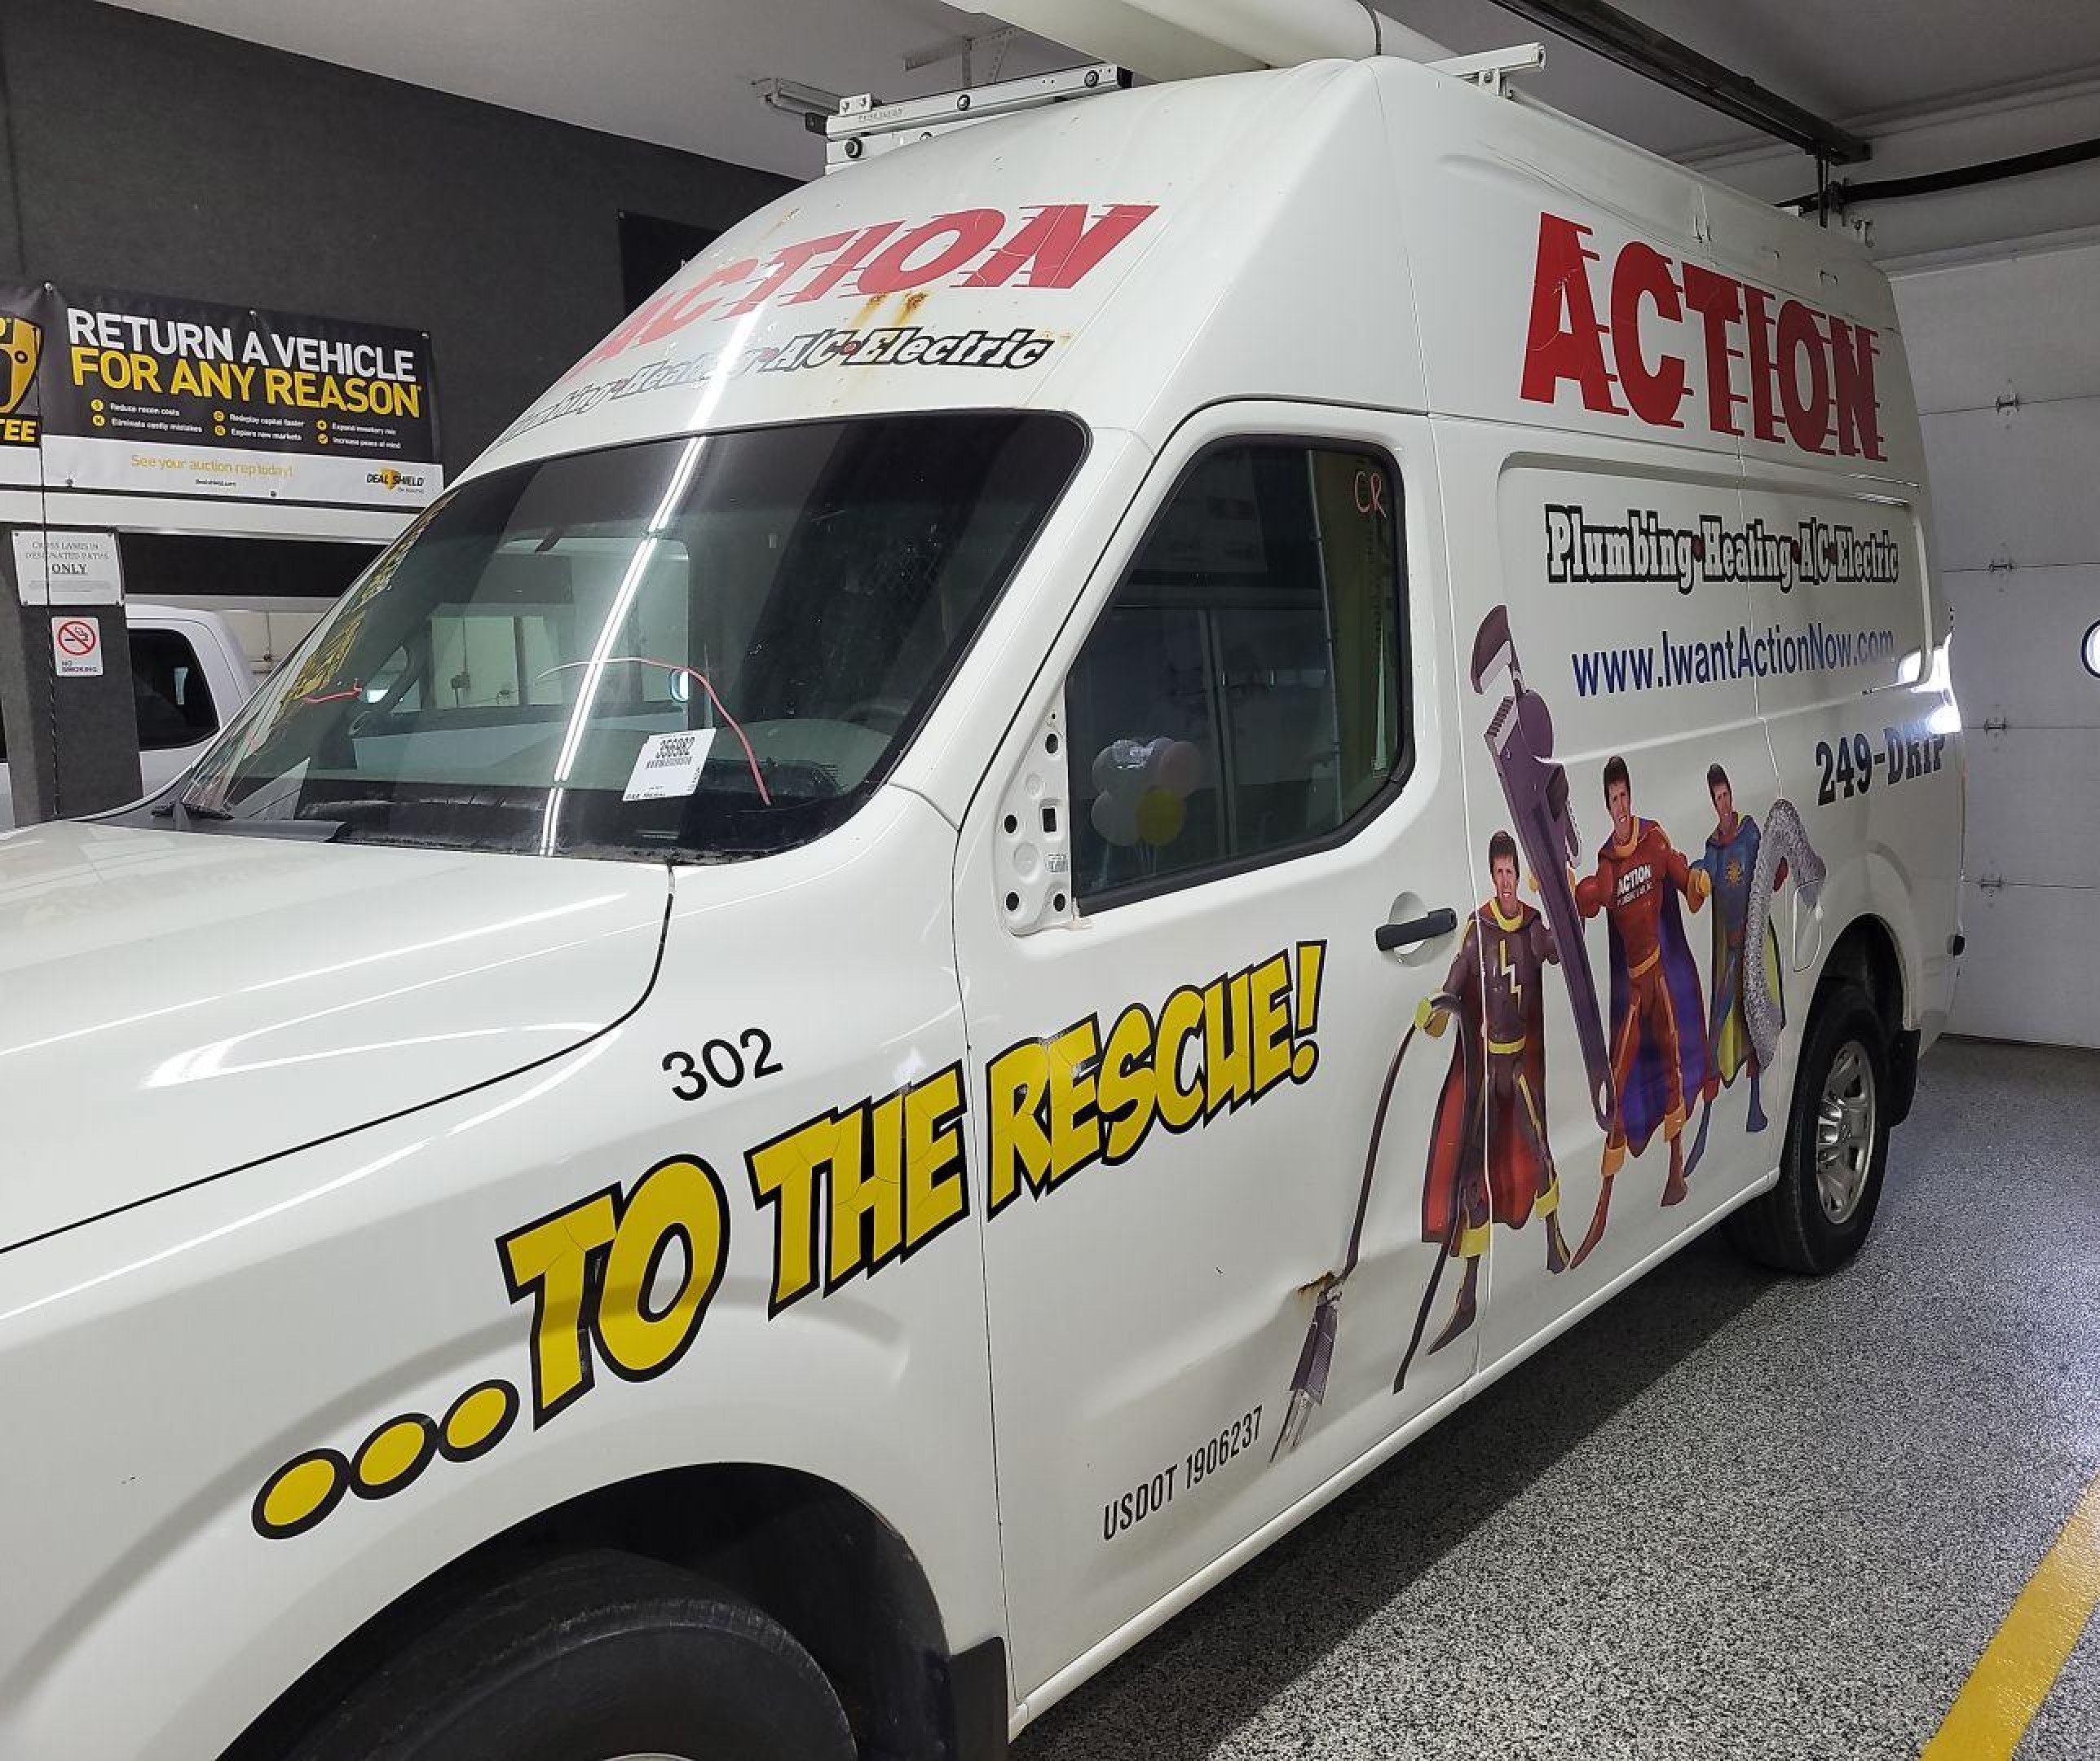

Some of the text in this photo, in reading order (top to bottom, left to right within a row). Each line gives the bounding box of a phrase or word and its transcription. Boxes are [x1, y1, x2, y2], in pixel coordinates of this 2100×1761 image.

[67, 307, 416, 382] RETURN A VEHICLE
[71, 346, 163, 394] FOR
[170, 358, 256, 402] ANY
[840, 325, 1056, 369] Electric
[1520, 211, 1887, 462] ACTION
[130, 454, 156, 468] See
[158, 458, 184, 470] your
[189, 458, 232, 472] auction
[51, 563, 89, 575] ONLY
[1544, 503, 1695, 595] Plumbing
[1698, 514, 1793, 594] Heating
[1833, 523, 1899, 585] Electric
[1571, 621, 1894, 698] www.IwantActionNow.com
[1617, 864, 1652, 897] ACTION
[662, 1027, 783, 1102] 302
[745, 1060, 969, 1321] THE
[986, 940, 1327, 1219] RESCUE!
[1103, 1404, 1263, 1541] USDOT 1906237
